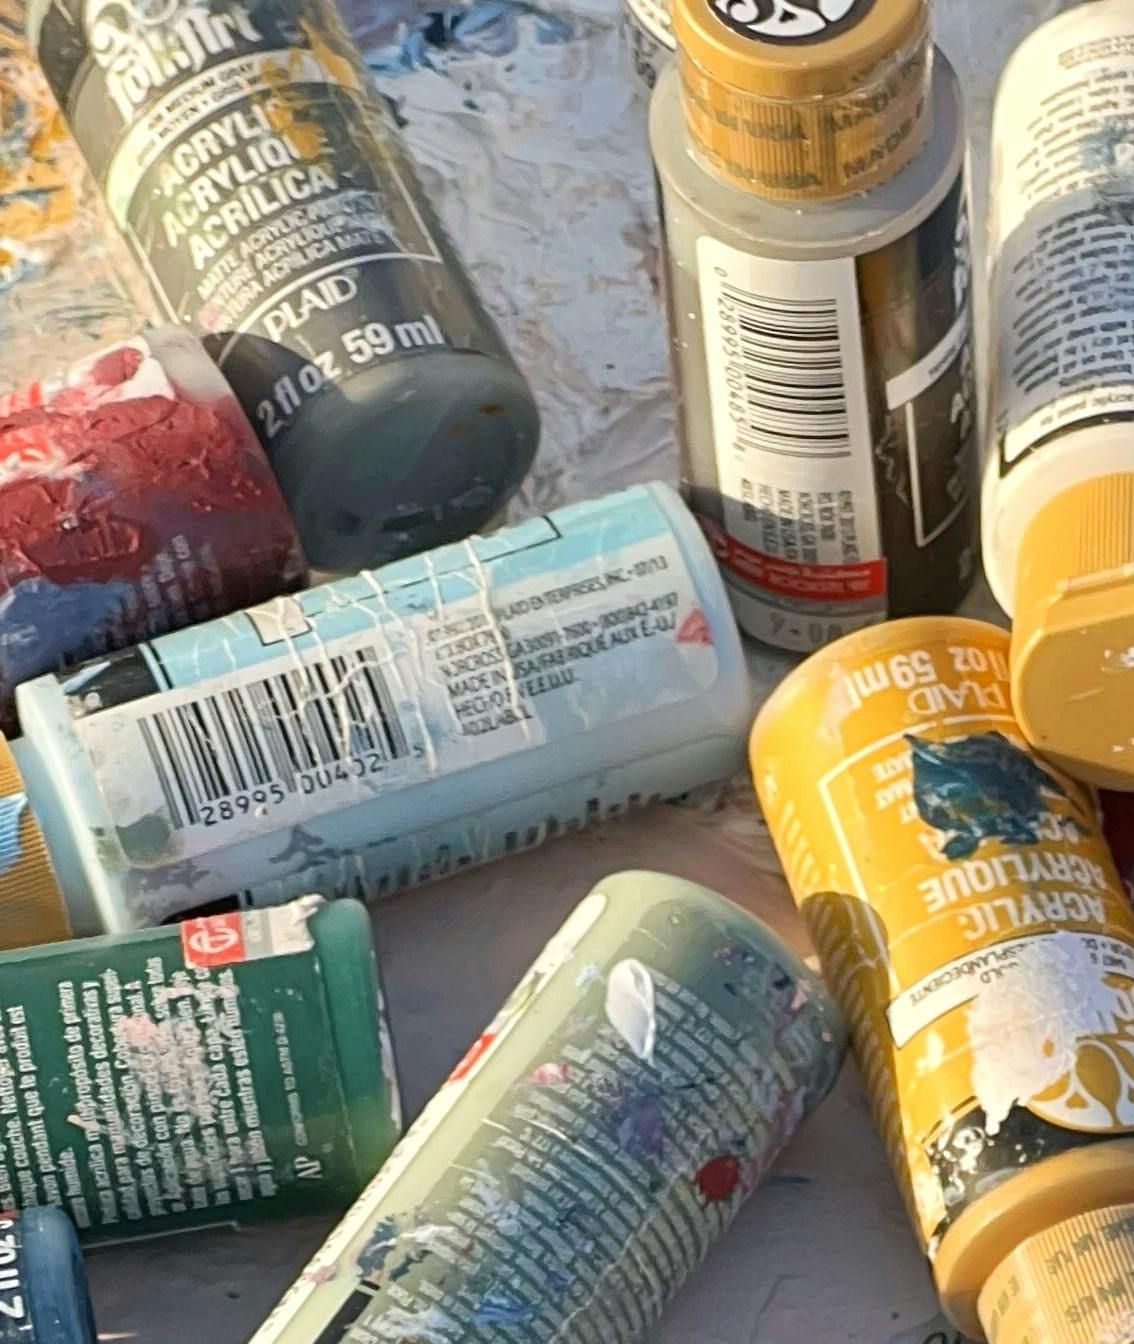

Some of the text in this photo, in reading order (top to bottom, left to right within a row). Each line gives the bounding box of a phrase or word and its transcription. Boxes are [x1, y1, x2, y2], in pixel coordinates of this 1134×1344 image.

[262, 274, 358, 343] PLAID
[255, 314, 446, 439] 2 fl oz 59 ml
[842, 662, 891, 710] ml
[889, 649, 938, 690] 59
[906, 679, 1010, 716] PLAID
[917, 851, 1110, 914] ACRYLIQUE
[962, 890, 1106, 941] ACRYLIC
[9, 1025, 38, 1073] produit
[63, 1025, 83, 1043] de
[23, 1089, 46, 1118] que
[26, 1117, 57, 1173] pendant
